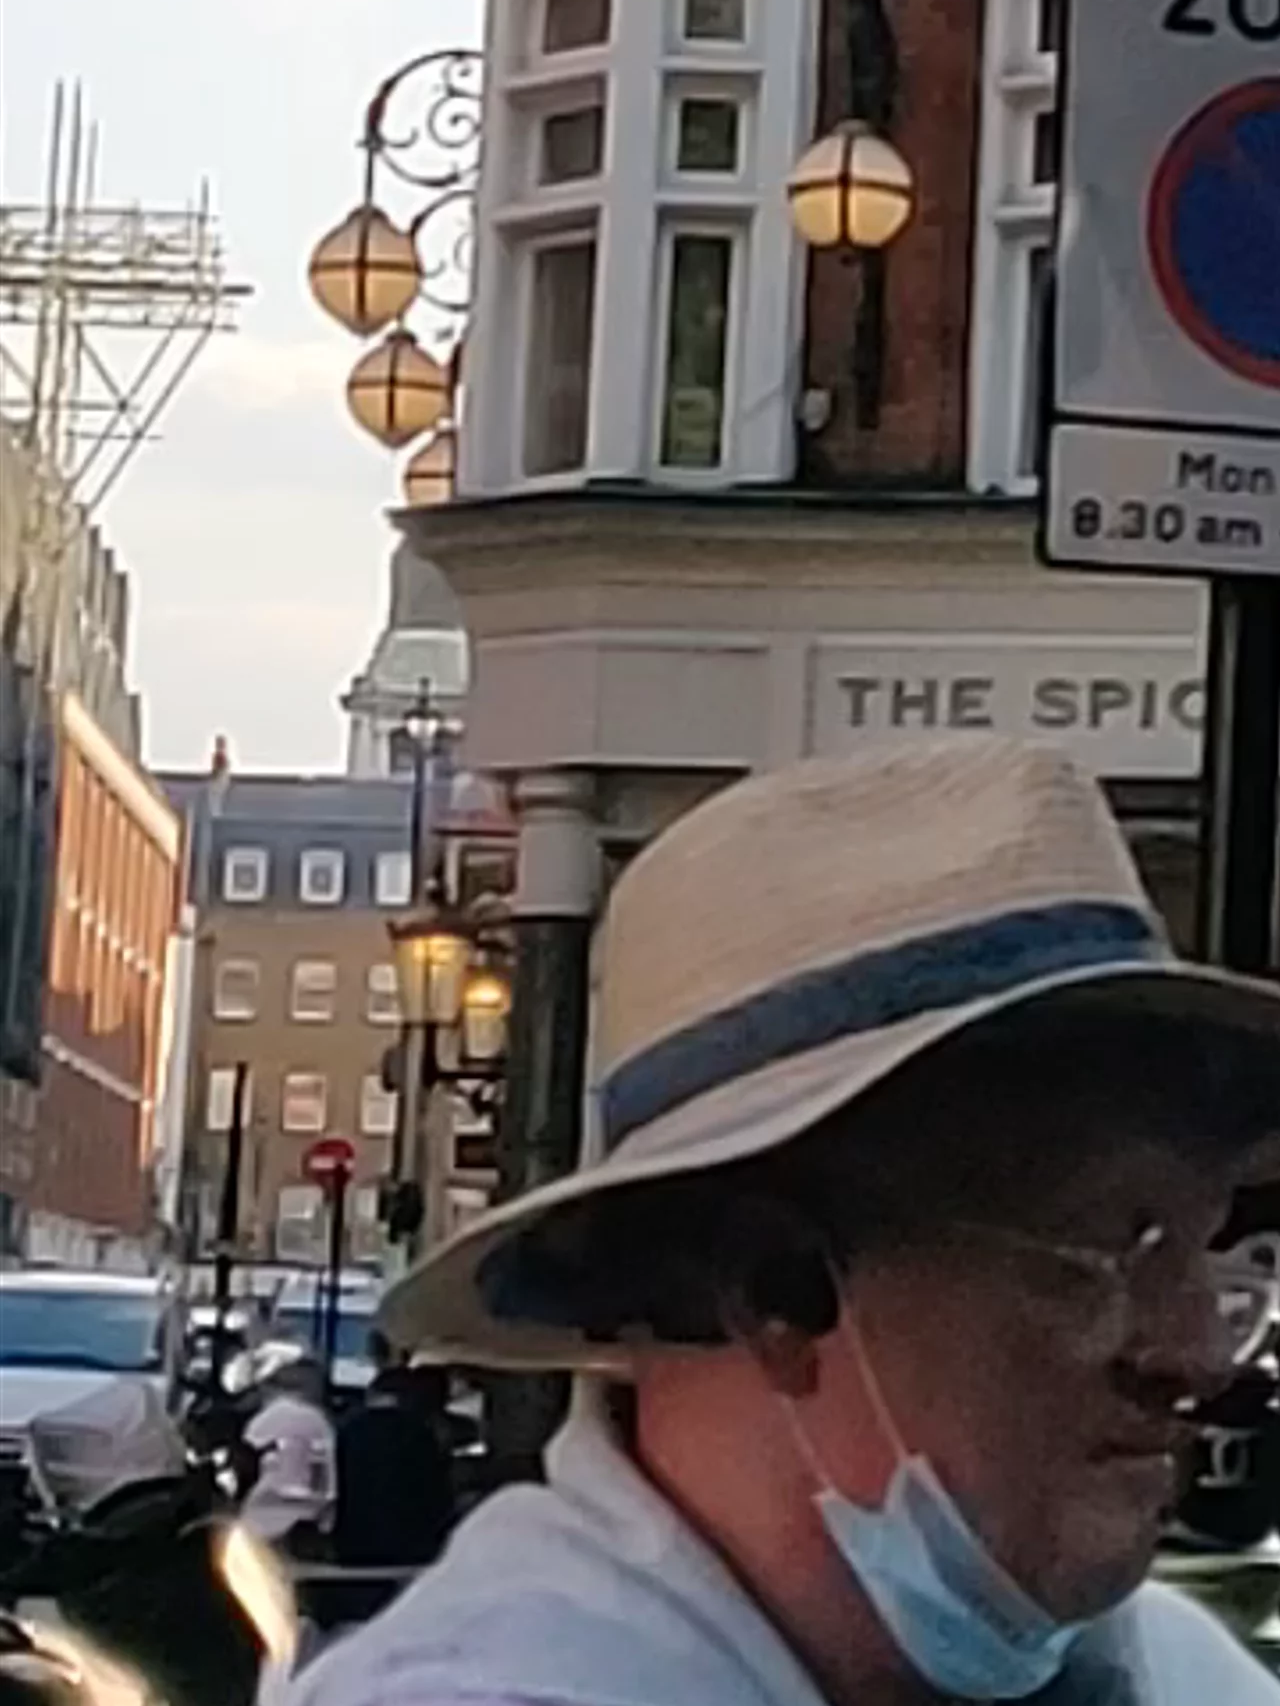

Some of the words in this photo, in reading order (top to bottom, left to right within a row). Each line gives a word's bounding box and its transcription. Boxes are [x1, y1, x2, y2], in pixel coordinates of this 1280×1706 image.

[1177, 452, 1275, 494] Mon
[1072, 499, 1183, 543] 8.30
[1195, 516, 1262, 547] am
[836, 676, 994, 731] THE
[1031, 676, 1206, 732] SPIC
